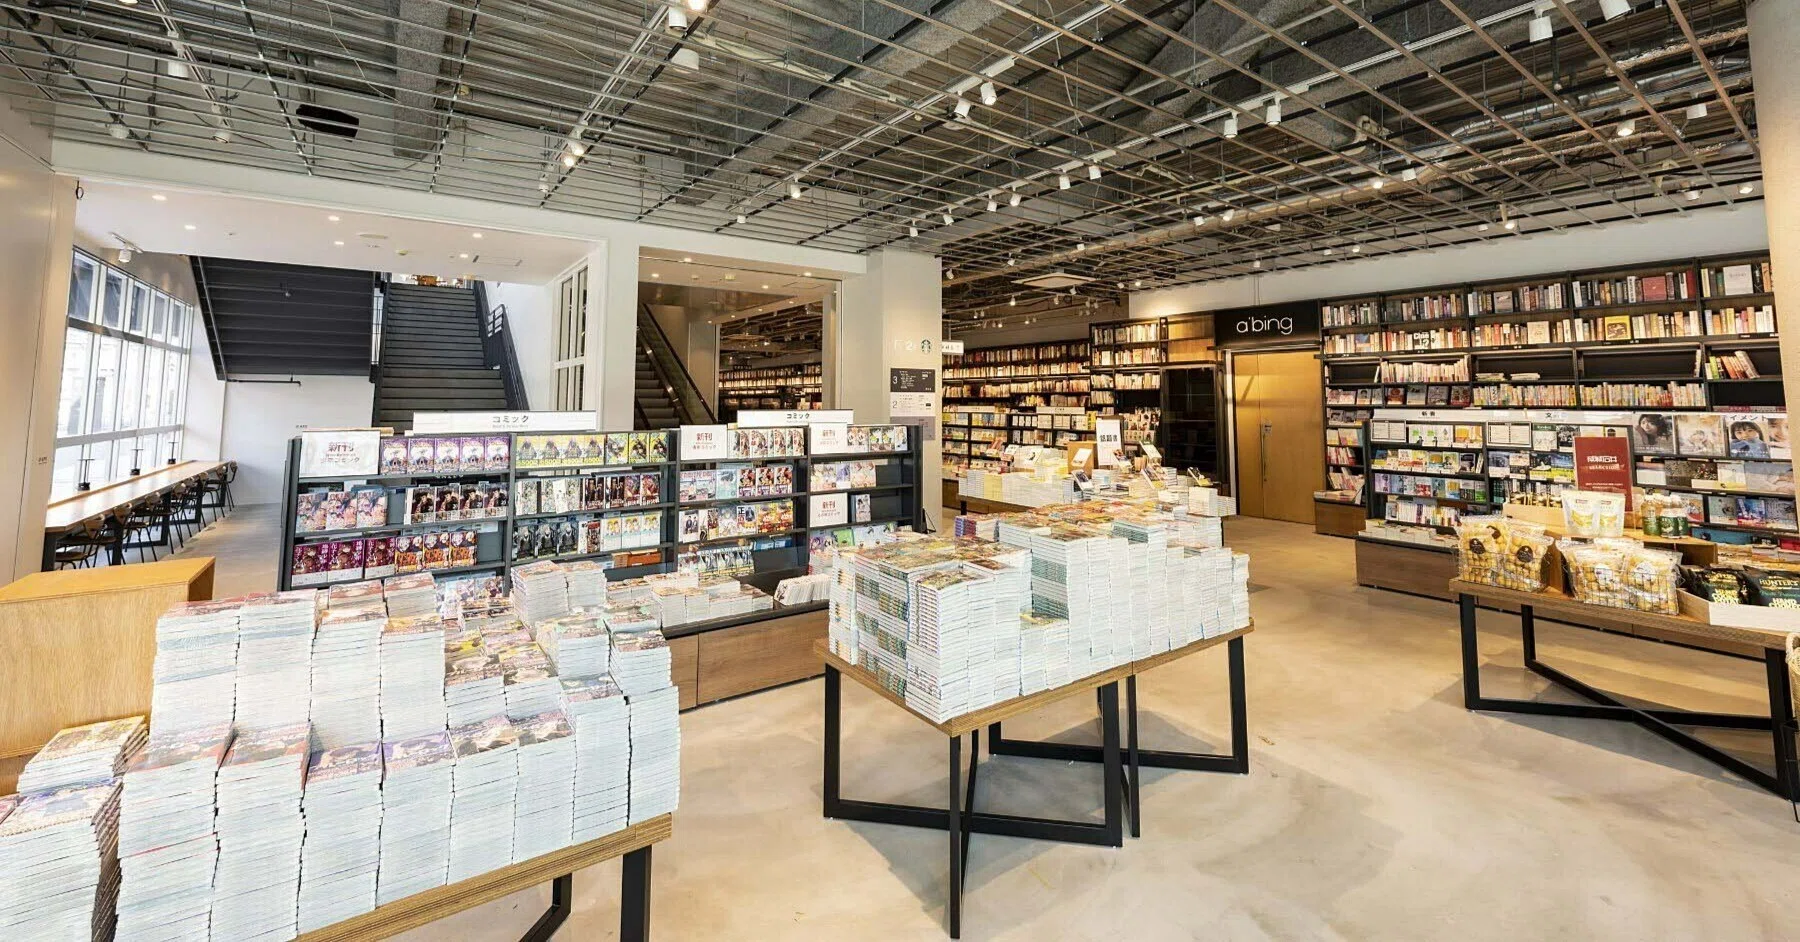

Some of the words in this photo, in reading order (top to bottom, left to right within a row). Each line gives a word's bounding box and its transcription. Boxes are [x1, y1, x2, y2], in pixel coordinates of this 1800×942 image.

[1236, 315, 1293, 335] a'bing
[892, 375, 898, 385] 3
[892, 400, 898, 409] 2
[493, 415, 529, 423] コミック
[696, 432, 713, 441] 新刊
[328, 441, 354, 452] 新刊
